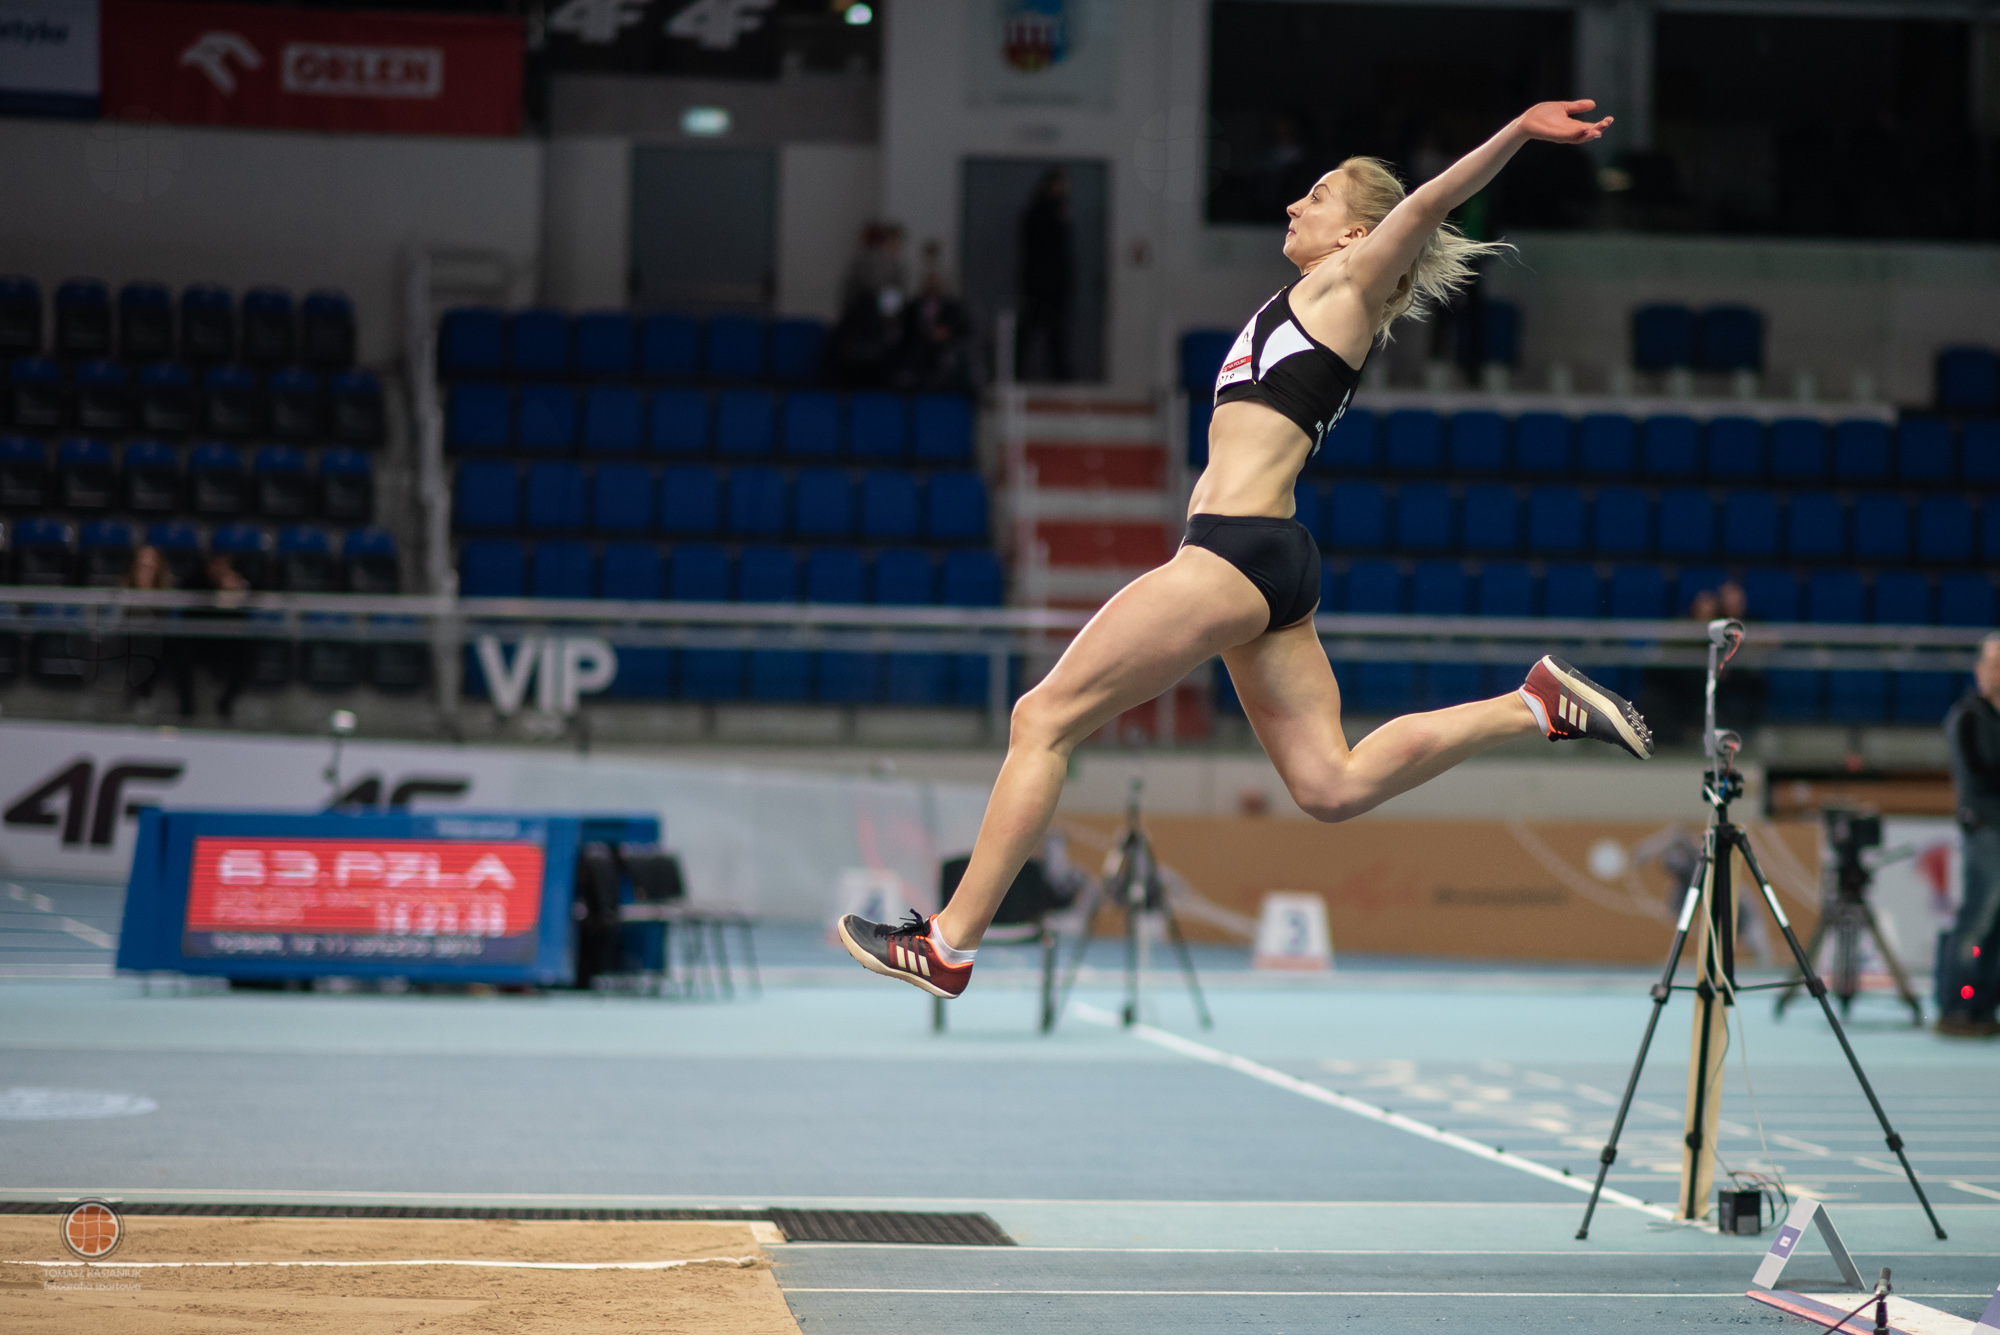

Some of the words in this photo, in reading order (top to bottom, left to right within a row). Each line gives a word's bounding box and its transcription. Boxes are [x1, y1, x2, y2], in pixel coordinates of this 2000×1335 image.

[293, 53, 430, 85] ORLEN
[475, 634, 619, 716] VIP
[3, 754, 186, 847] 4F
[334, 851, 516, 889] PZLA
